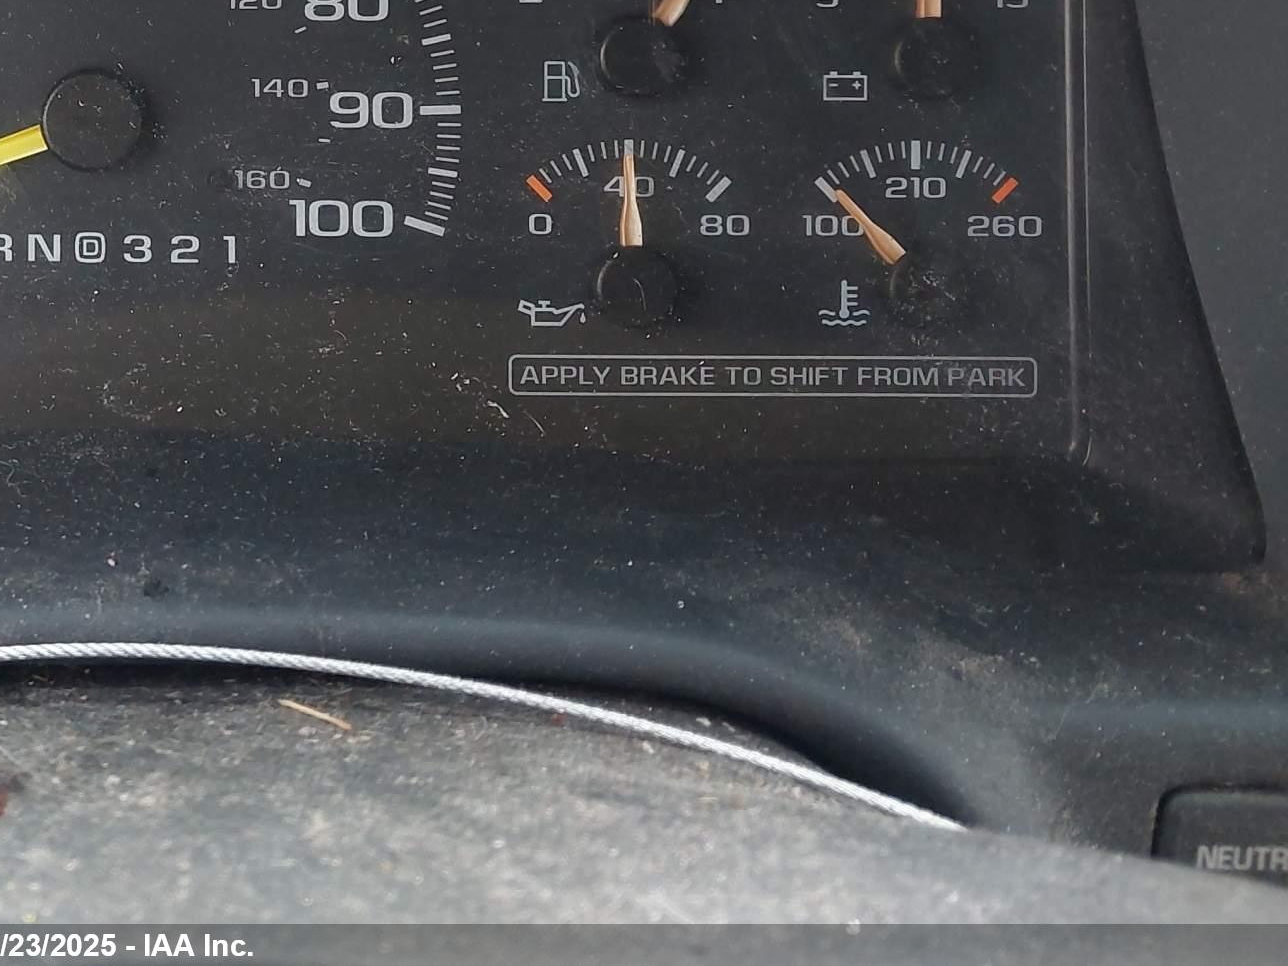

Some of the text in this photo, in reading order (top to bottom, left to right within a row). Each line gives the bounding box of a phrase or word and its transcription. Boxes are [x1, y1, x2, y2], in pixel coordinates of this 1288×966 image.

[251, 78, 309, 98] 140
[329, 91, 413, 129] 90
[234, 169, 290, 189] 160
[603, 177, 655, 198] 40
[885, 176, 946, 199] 210
[288, 199, 394, 238] 100
[528, 213, 553, 235] 0
[699, 214, 750, 236] 80
[802, 214, 863, 237] 100
[967, 215, 1042, 237] 260
[27, 233, 61, 262] N
[123, 234, 153, 263] 3
[170, 235, 200, 264] 2
[223, 235, 236, 264] 1
[519, 365, 1026, 387] APPLY BRAKE TO SHIFT FROM PARK
